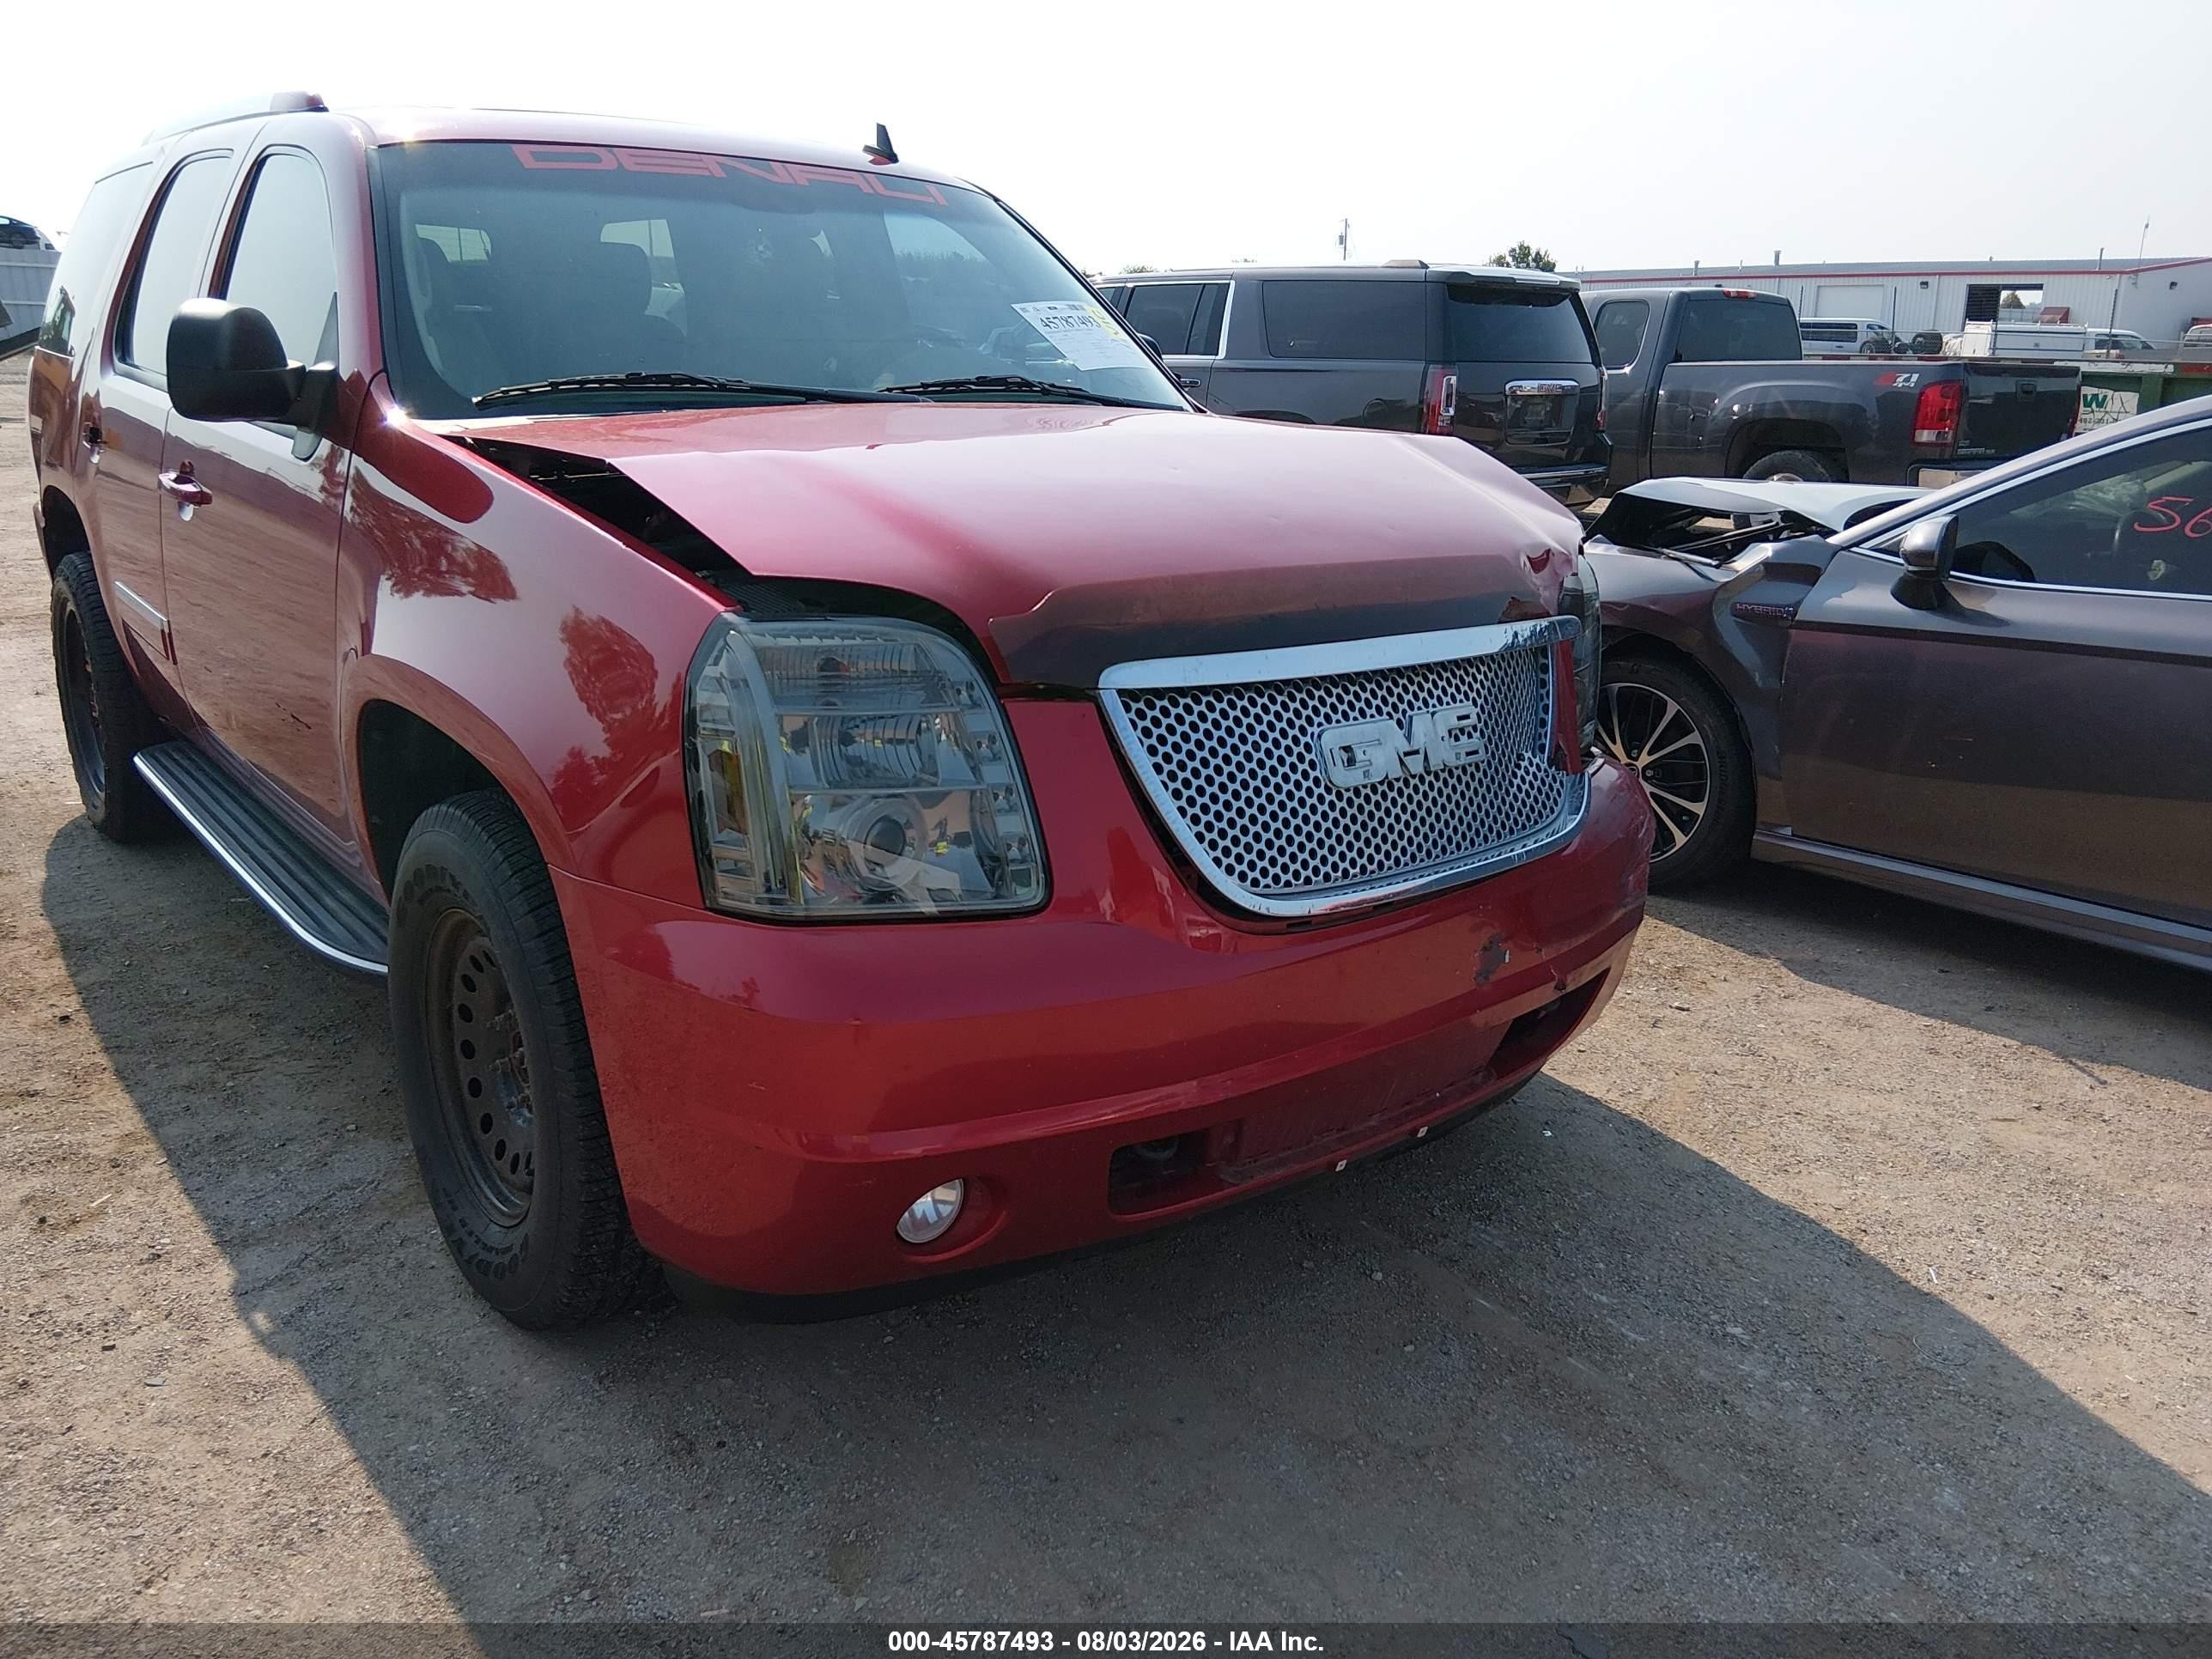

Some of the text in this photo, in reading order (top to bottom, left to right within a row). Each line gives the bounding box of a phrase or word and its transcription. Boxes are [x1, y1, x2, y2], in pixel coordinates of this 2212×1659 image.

[509, 143, 949, 207] DENALI
[1039, 314, 1103, 330] 45787493
[1735, 603, 1785, 616] HYBRID
[1316, 704, 1486, 789] GMC
